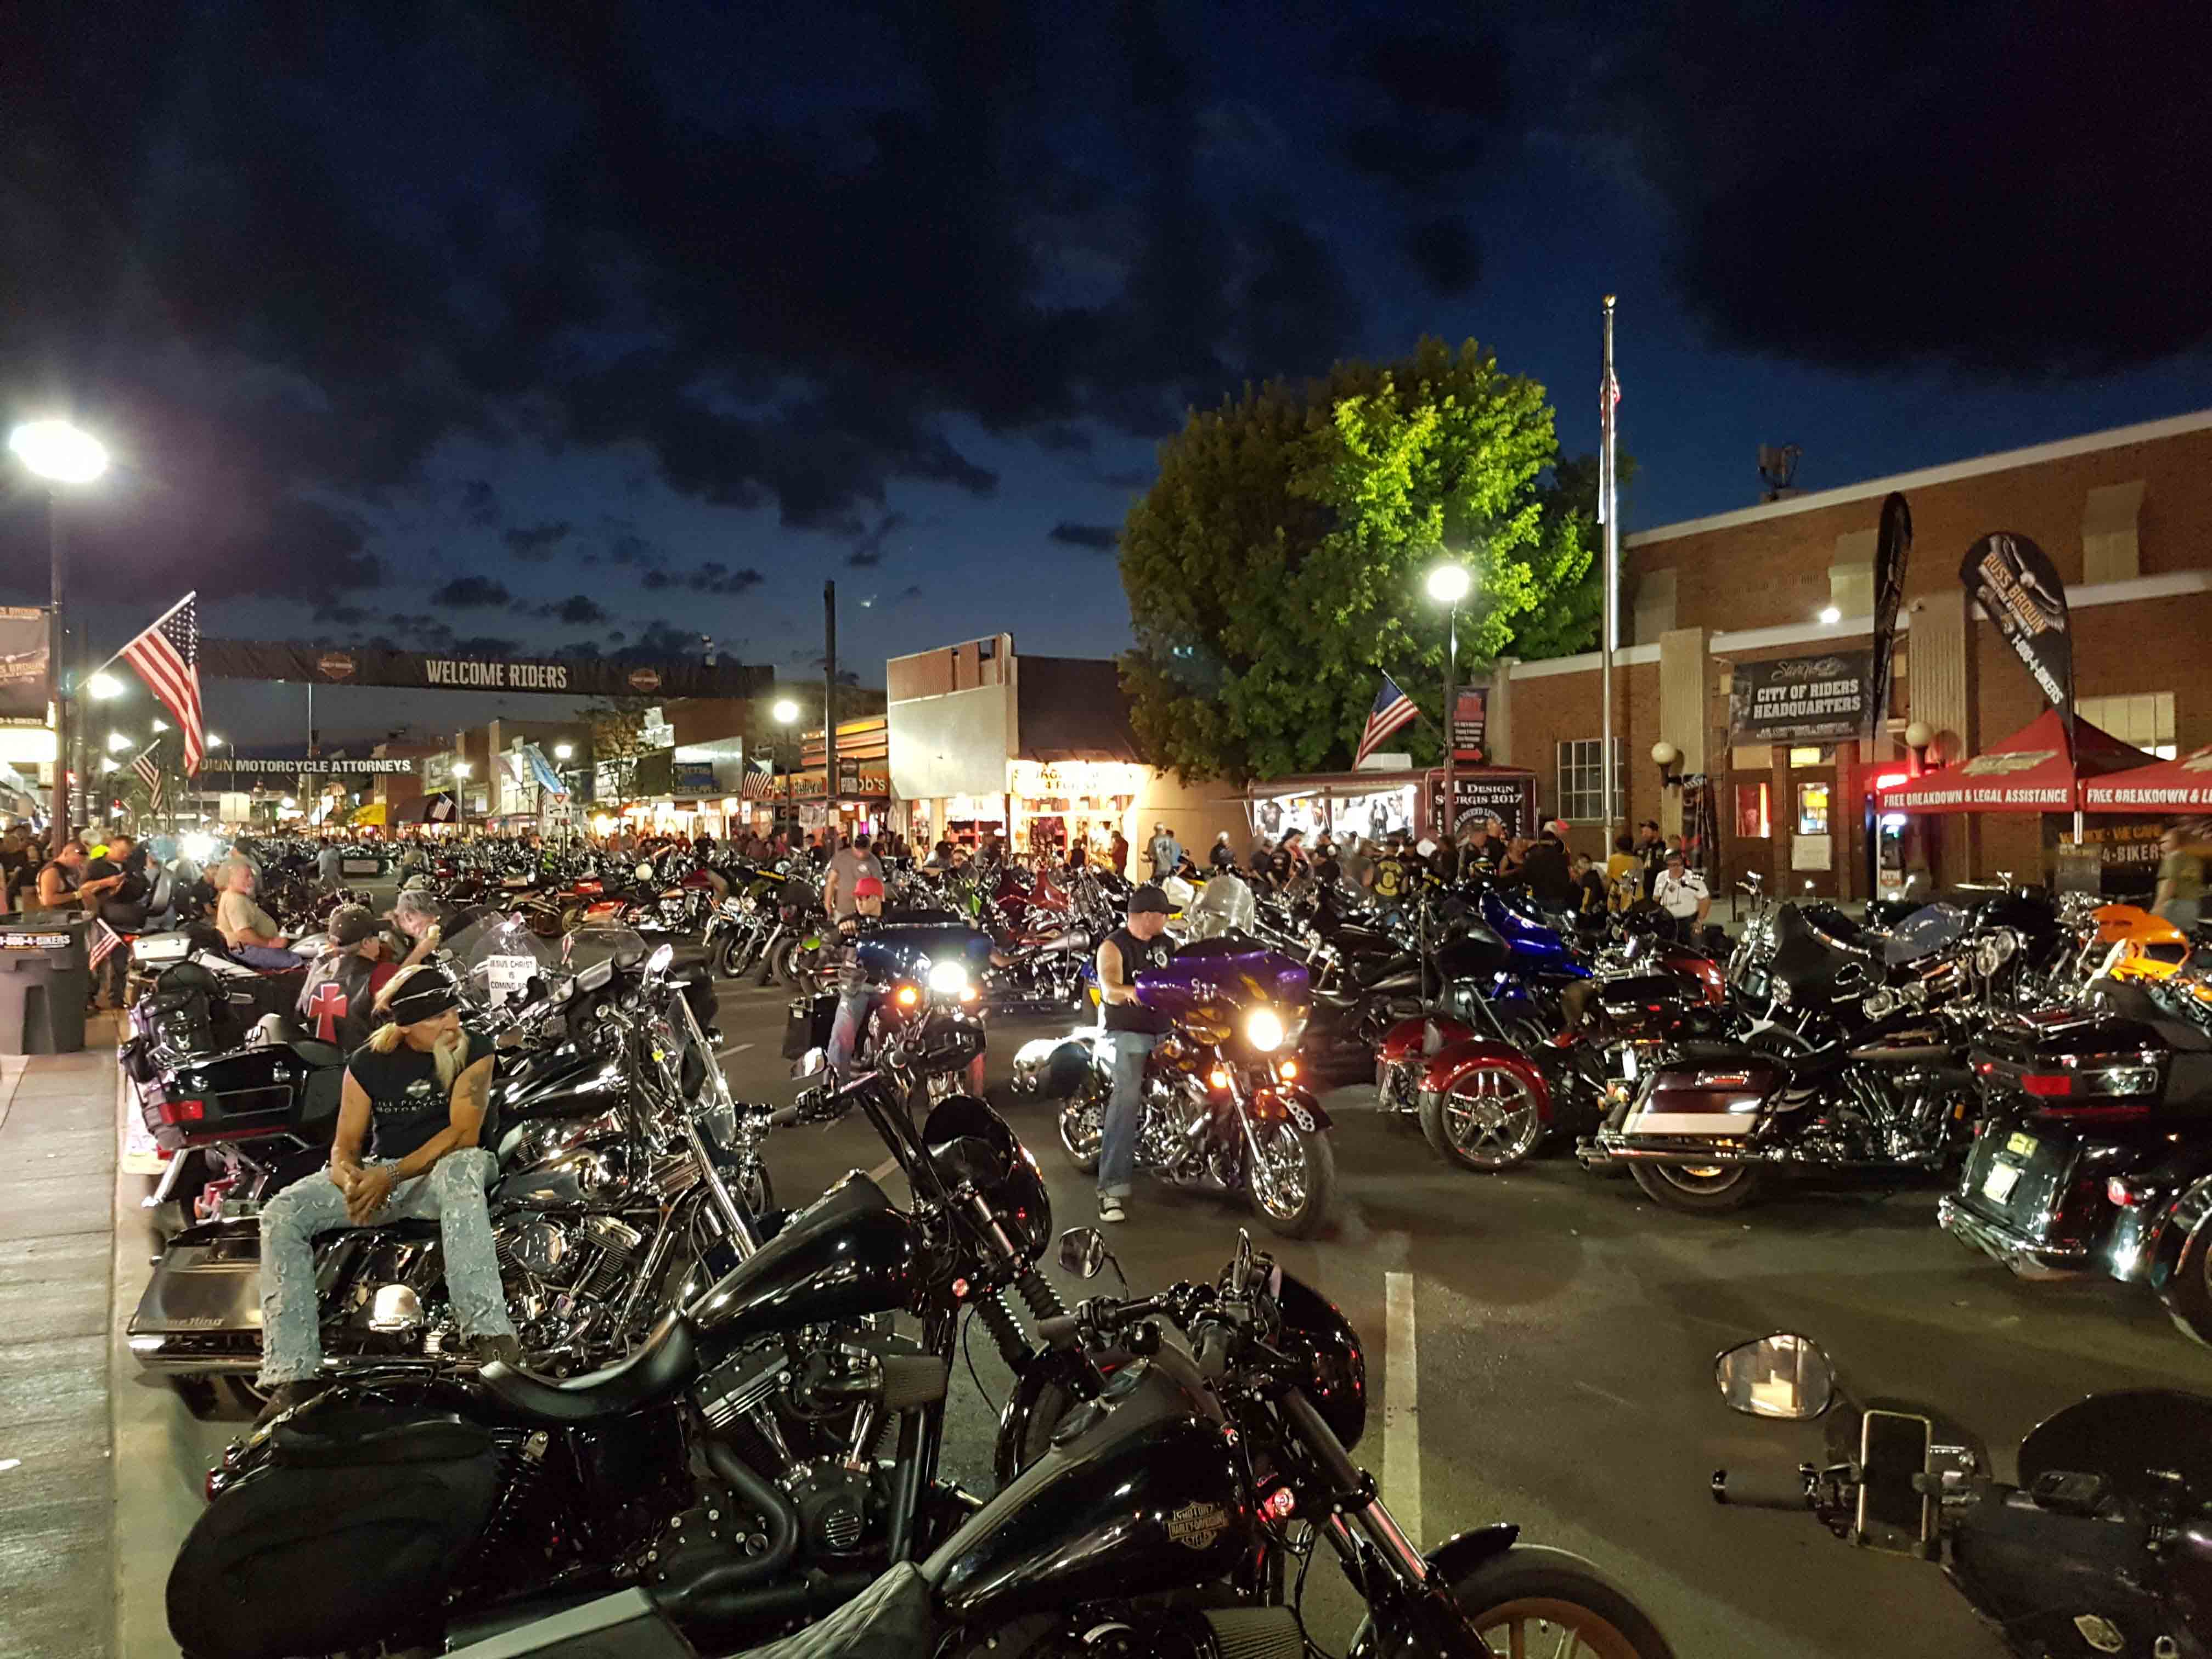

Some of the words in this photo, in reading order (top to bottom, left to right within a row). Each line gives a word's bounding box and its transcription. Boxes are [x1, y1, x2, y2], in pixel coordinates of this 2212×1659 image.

[1983, 552, 2014, 589] RUSS
[2007, 582, 2047, 633] BROWN
[426, 660, 504, 686] WELCOME
[509, 664, 567, 689] RIDERS
[1757, 687, 1787, 702] CITY
[1790, 684, 1807, 699] OF
[1810, 679, 1859, 698] RIDERS
[1753, 695, 1861, 720] HEADQUARTERS
[236, 760, 329, 773] MOTORCYCLE
[331, 759, 411, 772] ATTORNEYS
[859, 775, 885, 791] ob's
[1491, 794, 1523, 804] 2017
[1884, 793, 1905, 808] FREE
[1906, 790, 1962, 806] BREAKDOWN
[1965, 789, 1972, 803] &
[1973, 788, 2002, 803] LEGAL
[2005, 788, 2068, 804] ASSISTANCE
[2087, 788, 2113, 803] FREE
[2115, 788, 2188, 803] BREAKDOWN
[2189, 788, 2199, 804] &
